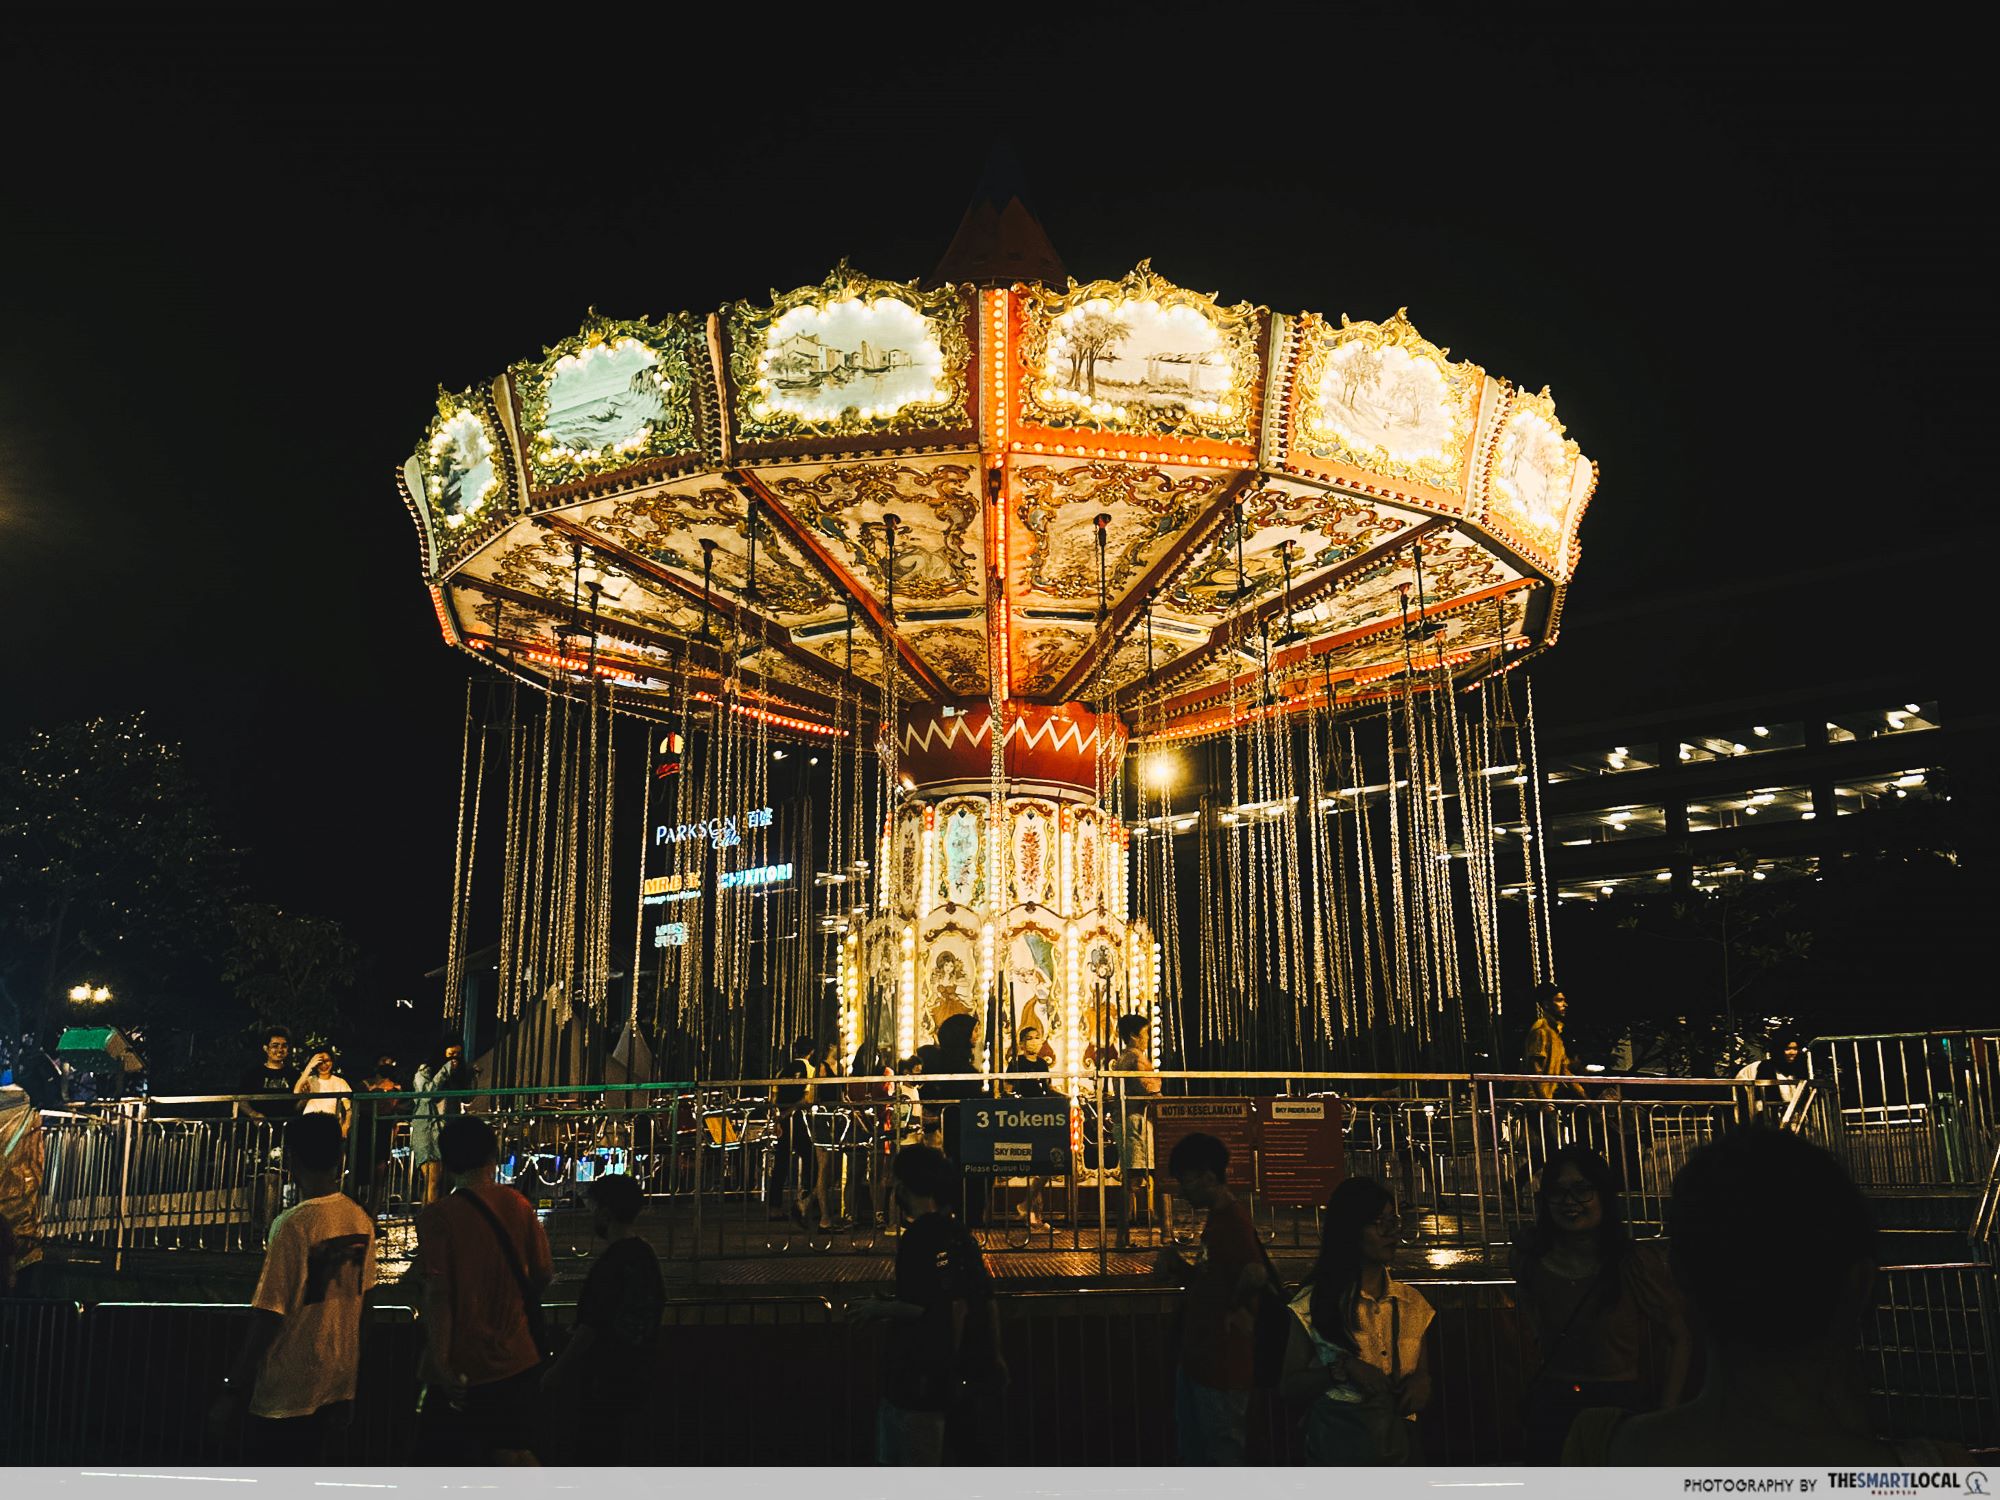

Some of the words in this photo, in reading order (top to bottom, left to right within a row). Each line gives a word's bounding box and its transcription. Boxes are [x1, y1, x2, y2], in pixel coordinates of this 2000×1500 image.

[656, 815, 736, 846] PARKSON
[1161, 1105, 1185, 1116] NOTIS
[1187, 1105, 1242, 1116] KESELAMATAN
[976, 1110, 990, 1128] 3
[994, 1110, 1066, 1127] Tokens
[994, 1147, 1009, 1156] SKY
[1010, 1147, 1032, 1156] RIDER
[964, 1164, 990, 1173] Please
